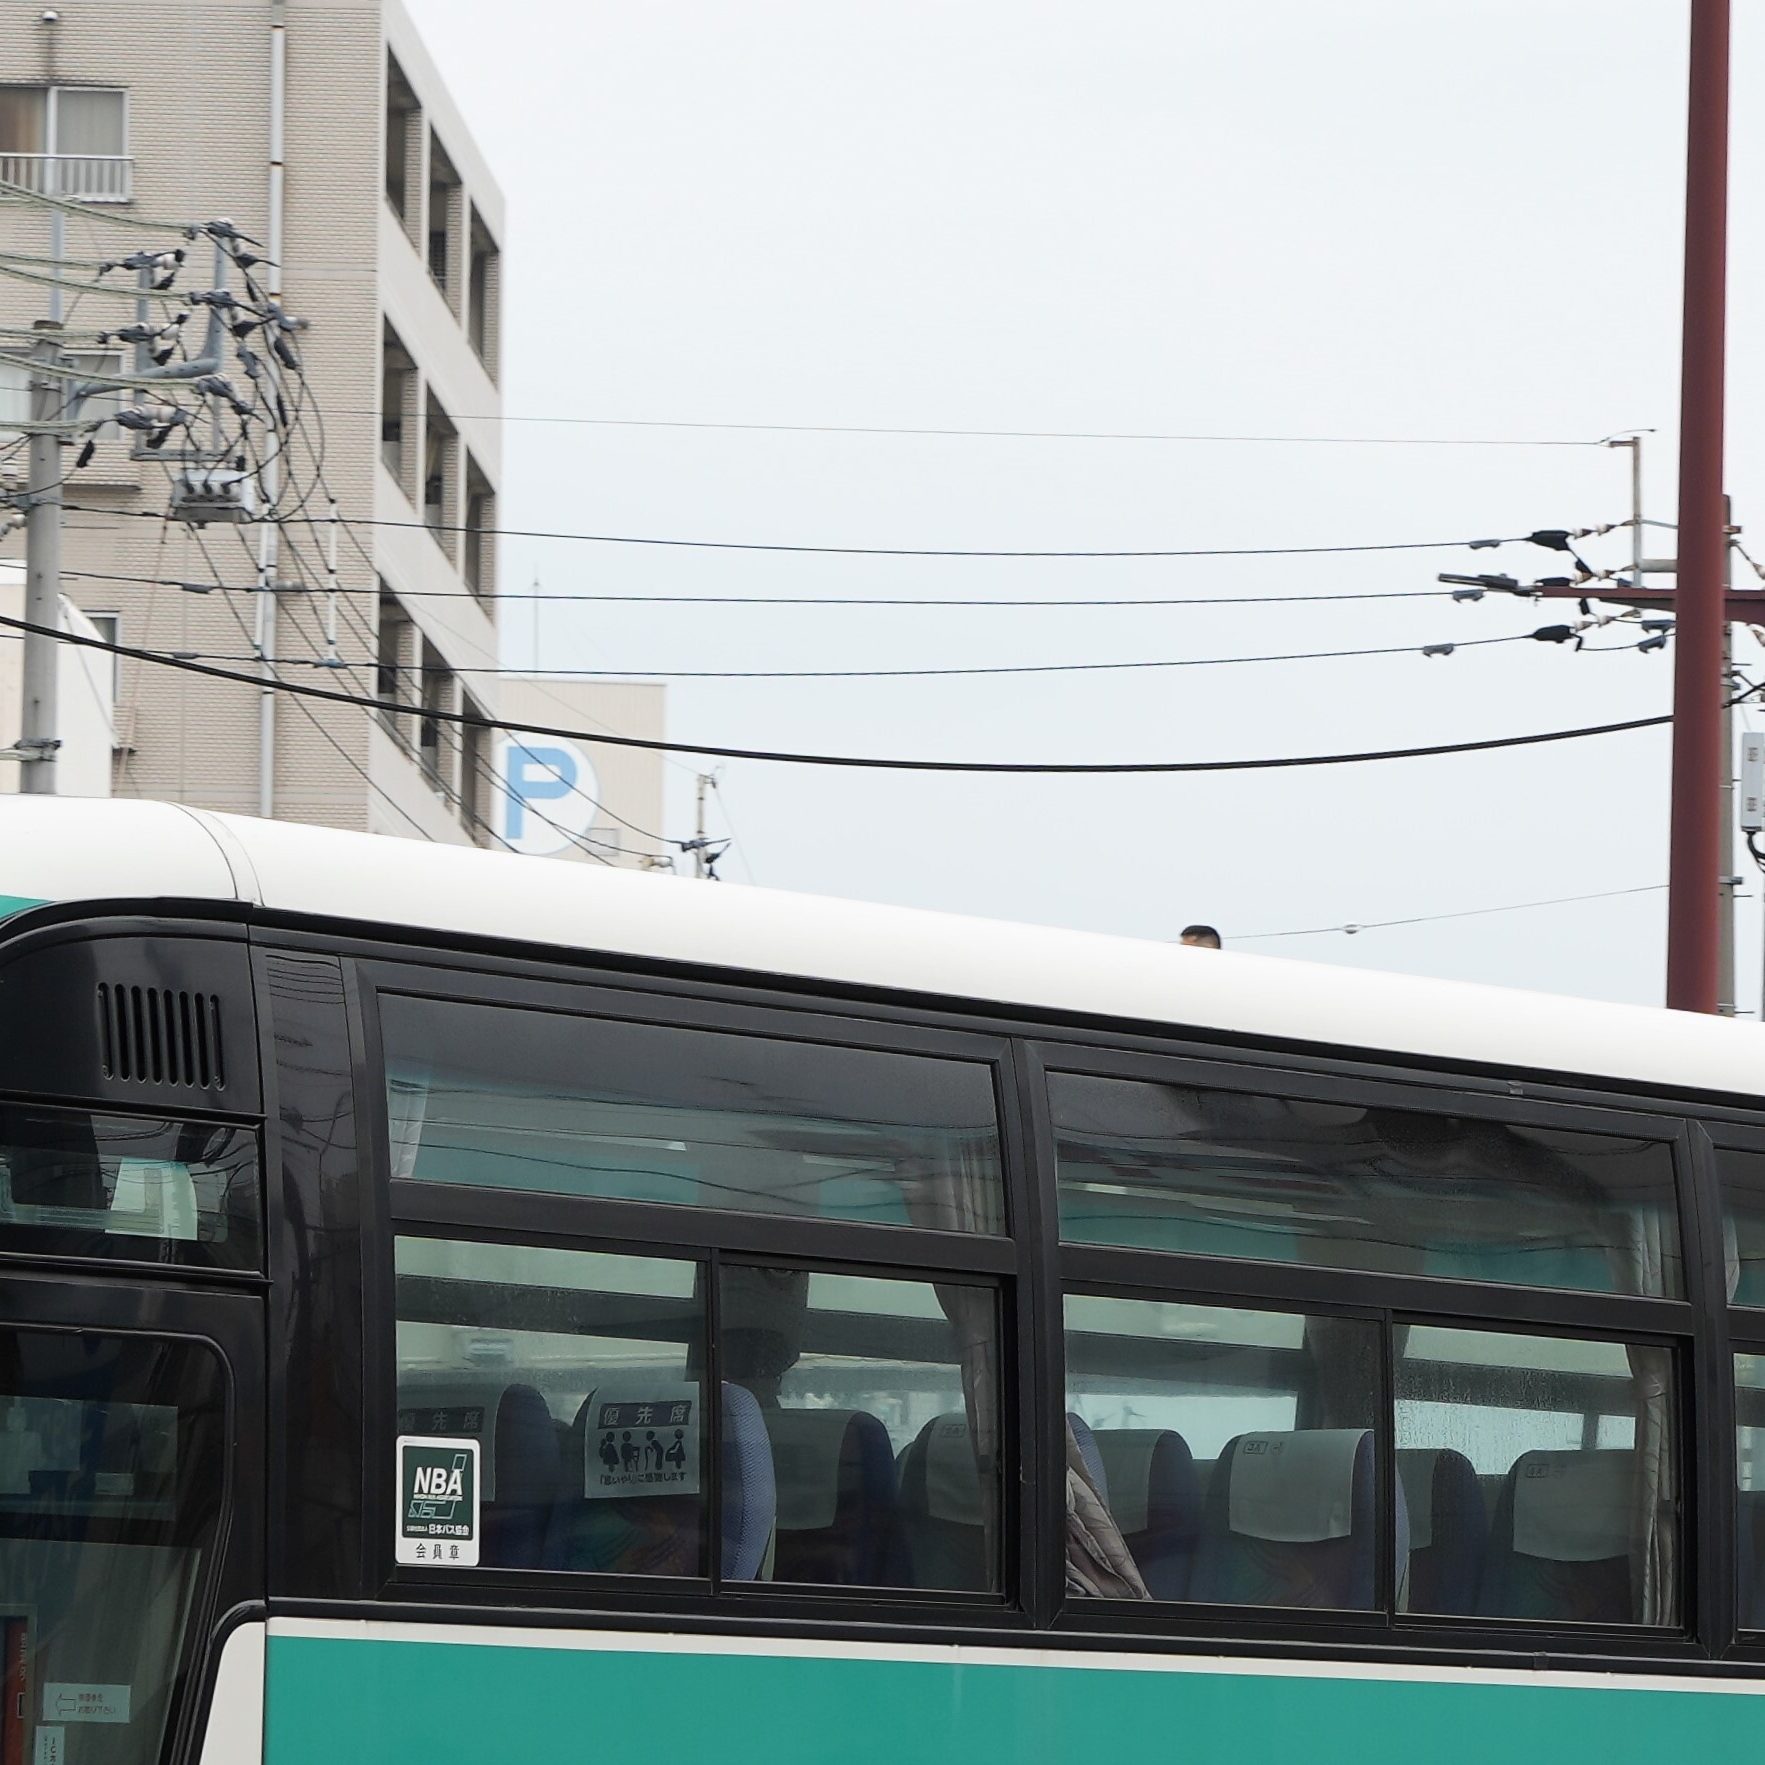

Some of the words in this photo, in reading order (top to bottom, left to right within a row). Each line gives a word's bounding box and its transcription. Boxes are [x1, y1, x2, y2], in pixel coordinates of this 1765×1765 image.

[506, 746, 578, 839] P
[603, 1404, 688, 1426] 優先席
[413, 1466, 463, 1495] NBA
[415, 1542, 460, 1560] 会員章
